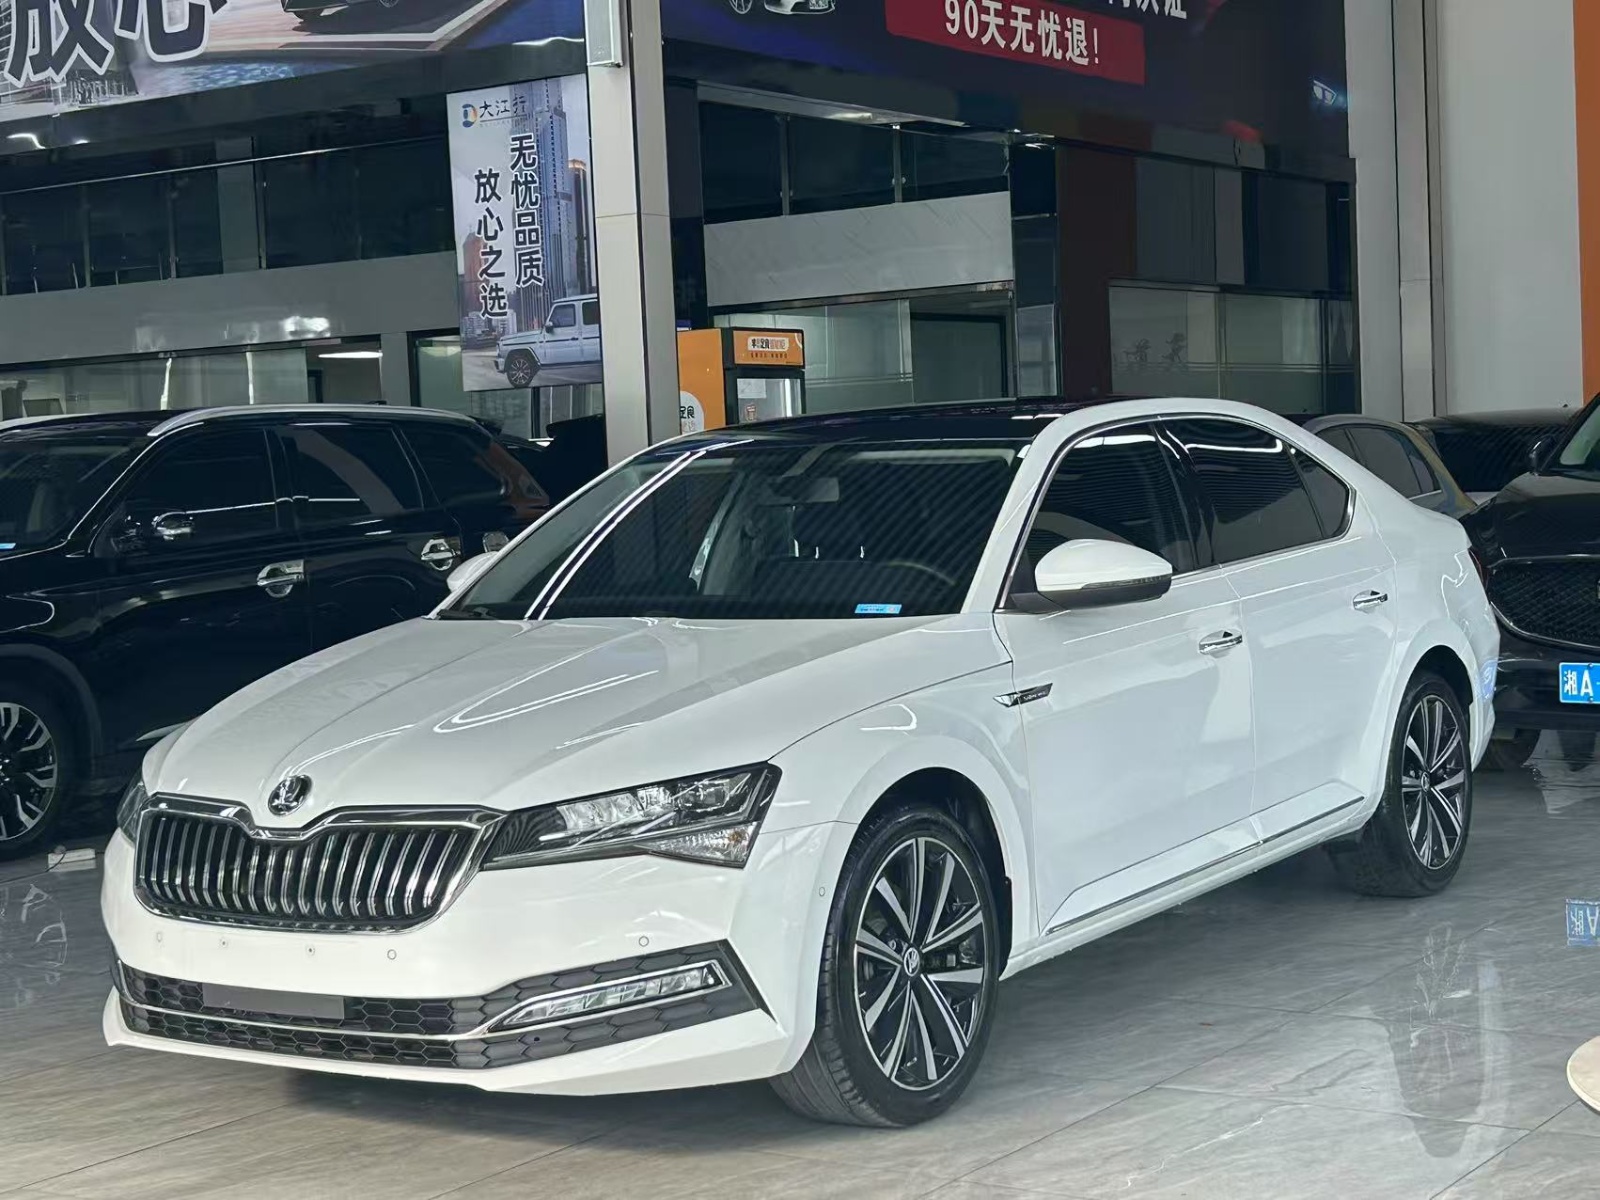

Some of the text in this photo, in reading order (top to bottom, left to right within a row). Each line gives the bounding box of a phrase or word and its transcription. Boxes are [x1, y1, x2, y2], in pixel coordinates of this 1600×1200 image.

[473, 167, 508, 318] 放心之选
[509, 133, 544, 287] 无忧品质
